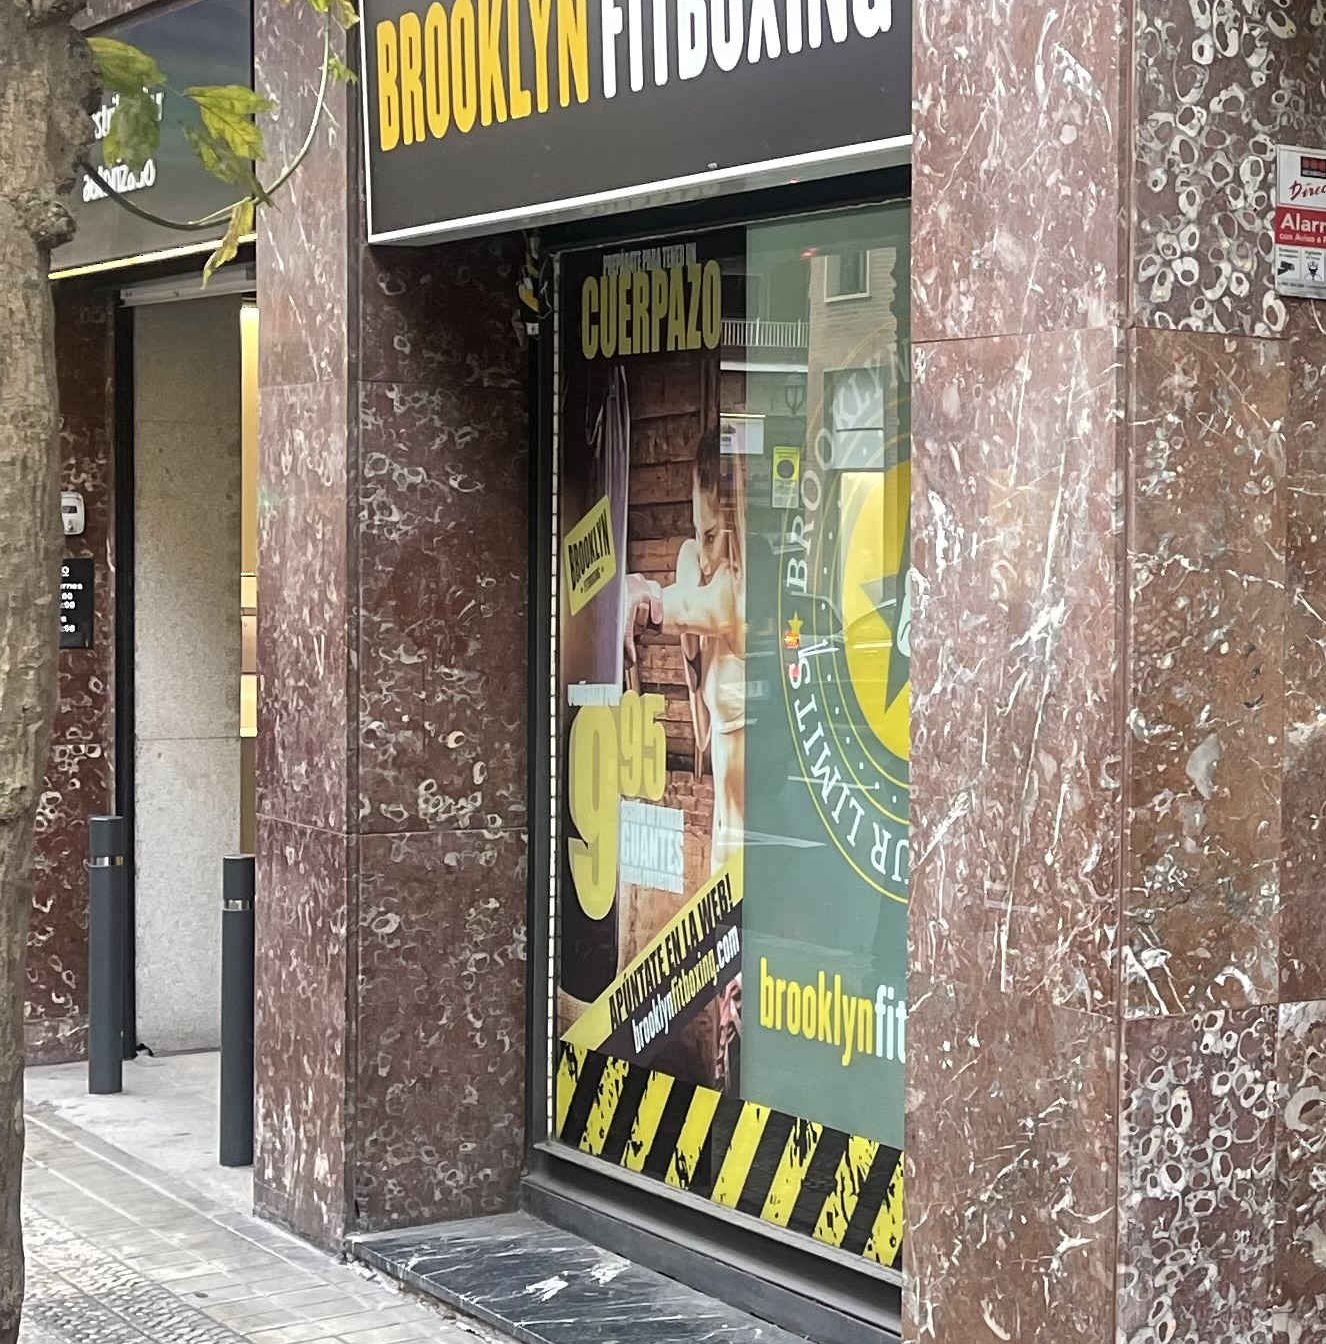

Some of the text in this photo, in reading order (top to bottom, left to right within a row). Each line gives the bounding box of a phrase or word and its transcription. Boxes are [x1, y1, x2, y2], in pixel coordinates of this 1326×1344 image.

[581, 259, 721, 360] CUERPAZO
[785, 337, 911, 596] BROOKLYN
[568, 507, 611, 592] BROOKLYN
[788, 660, 865, 847] LIMITS
[620, 821, 685, 876] GUANTES
[608, 872, 734, 1031] APÚNTATE EN LA WEB!
[631, 924, 741, 1054] brooklynfitboxing.com
[760, 957, 907, 1066] brooklynfit
